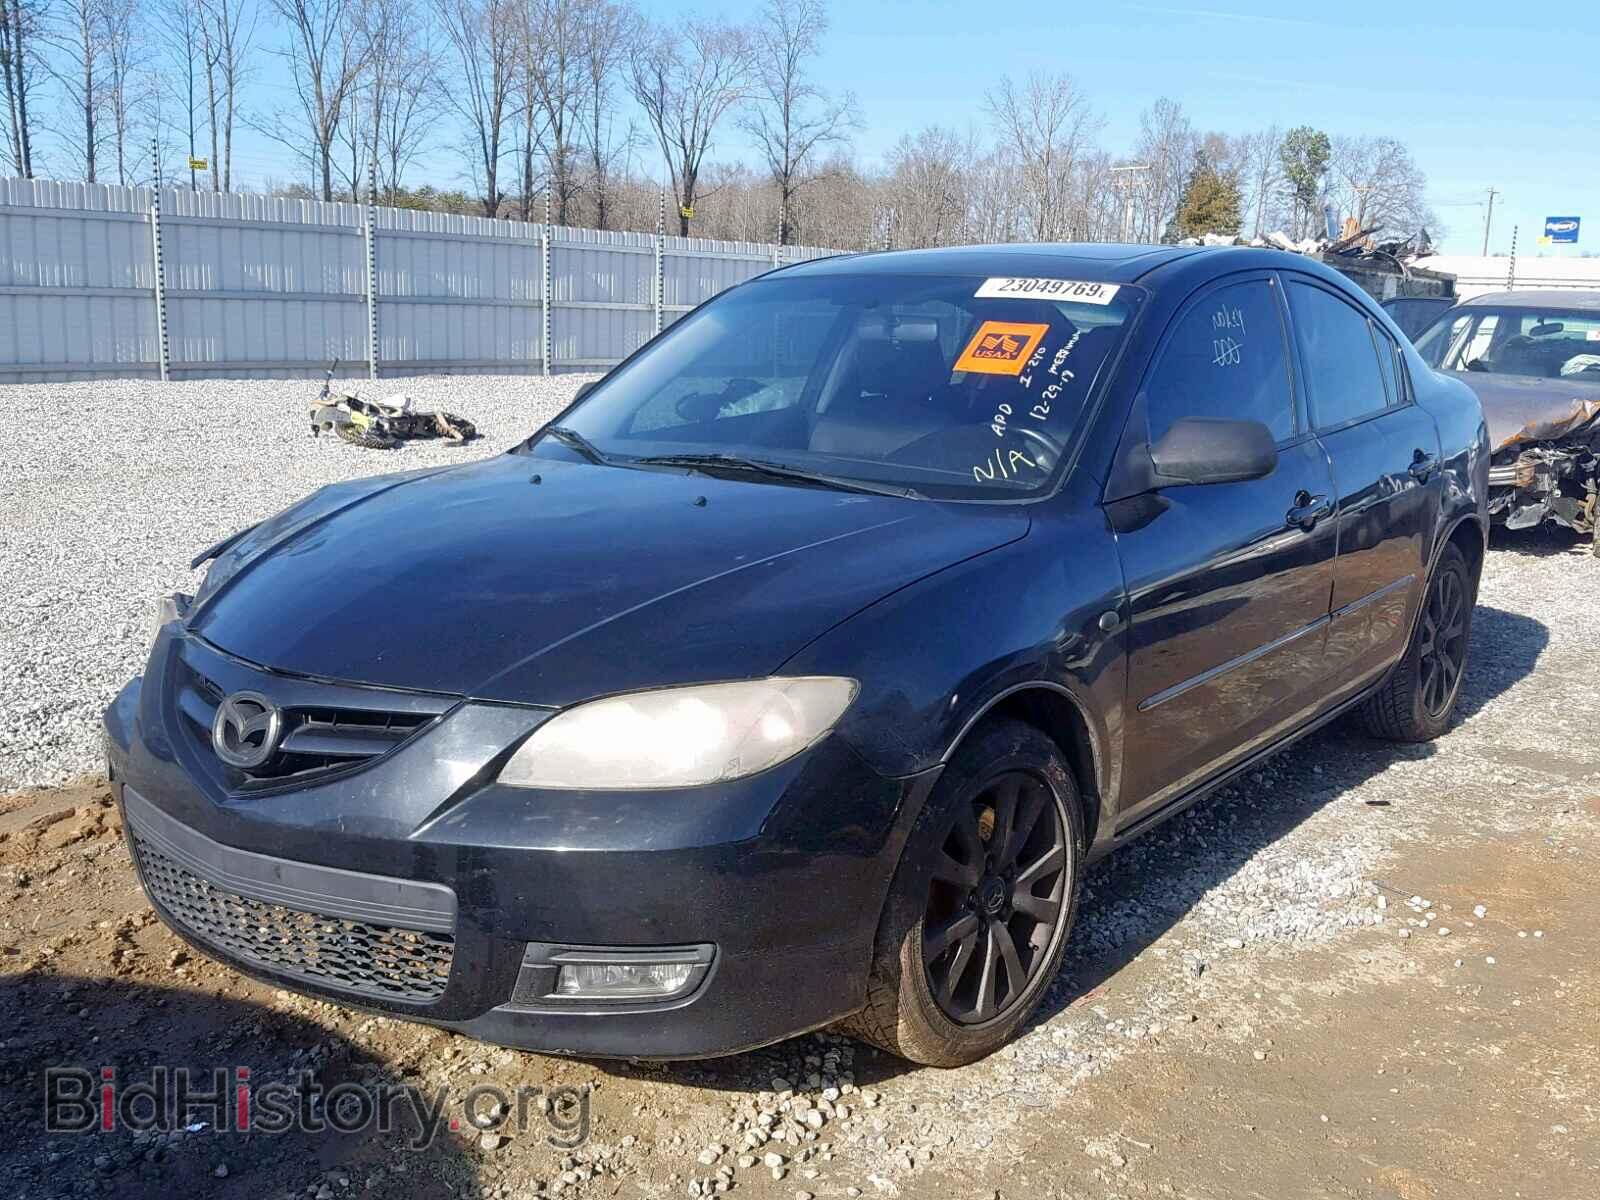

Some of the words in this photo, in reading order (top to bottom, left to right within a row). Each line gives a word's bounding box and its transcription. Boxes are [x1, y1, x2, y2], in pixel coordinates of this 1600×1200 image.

[974, 350, 1011, 359] USAA
[991, 403, 1012, 437] APD
[973, 448, 1036, 482] N/A
